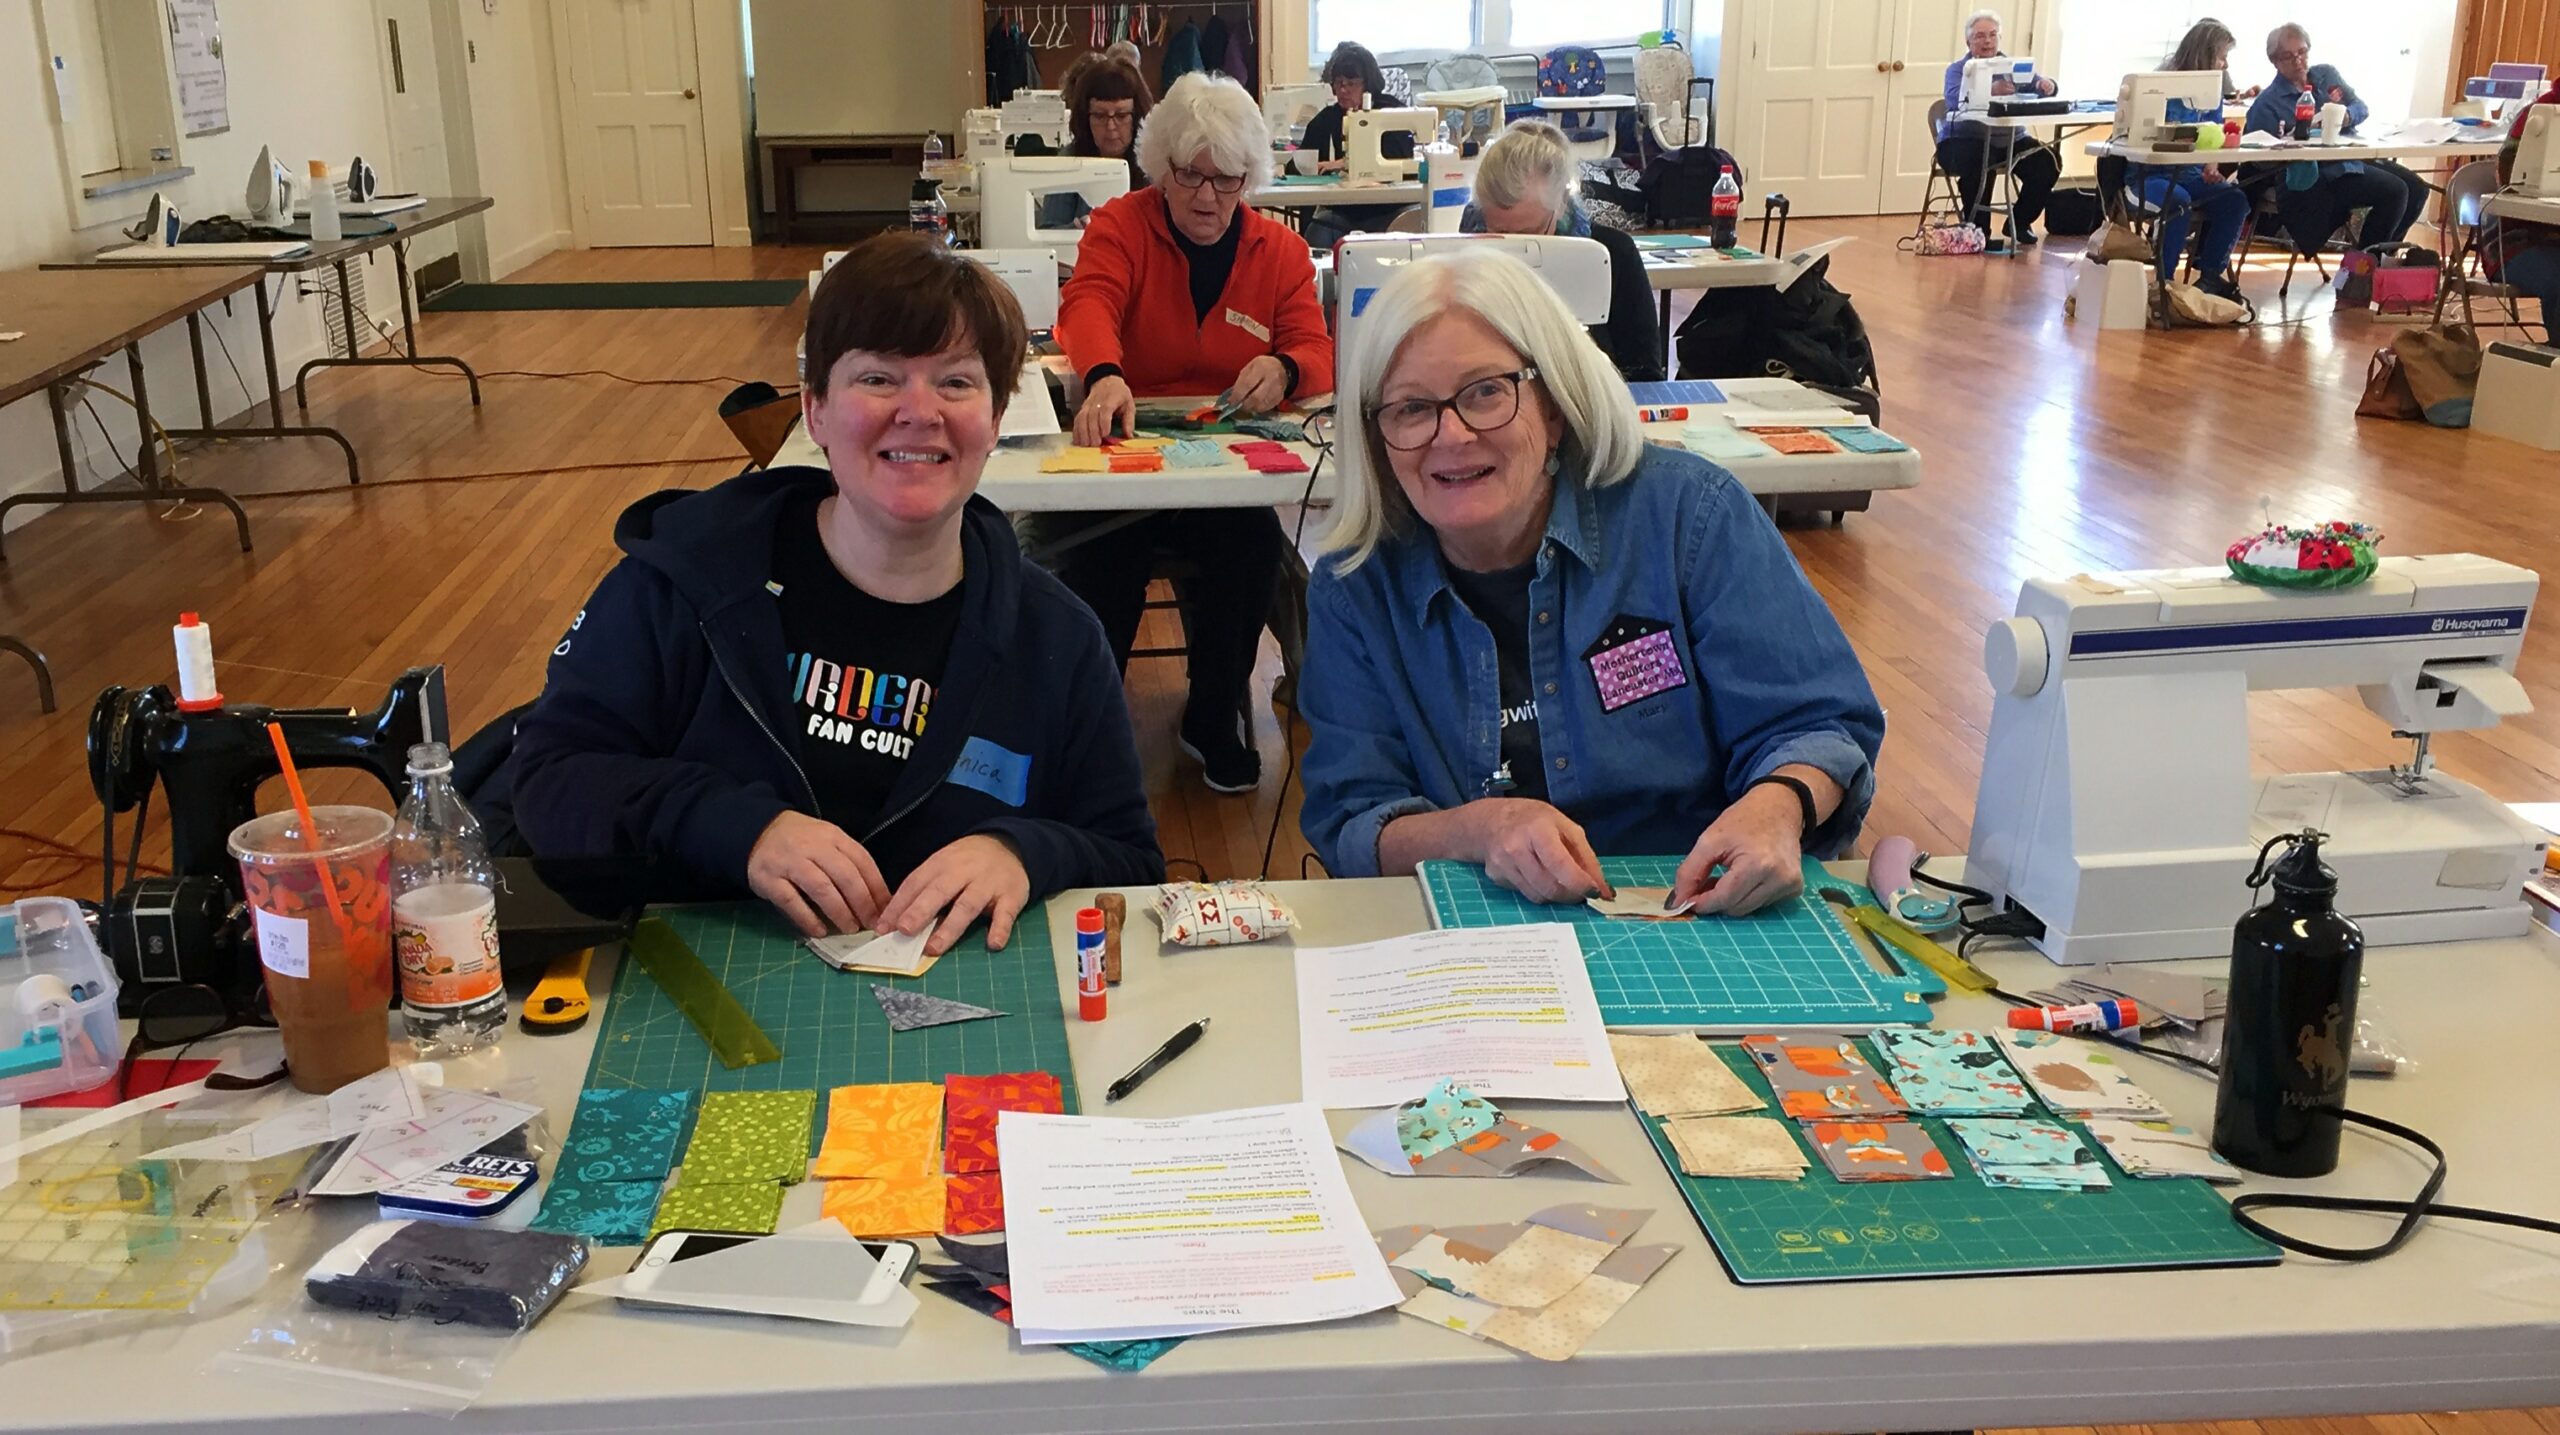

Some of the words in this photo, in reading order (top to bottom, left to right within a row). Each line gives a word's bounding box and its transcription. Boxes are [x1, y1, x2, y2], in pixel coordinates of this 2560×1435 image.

[2445, 617, 2509, 630] Husqvarna
[1600, 642, 1670, 673] Mothertown
[1616, 659, 1663, 682] Quilters
[1602, 674, 1661, 701] Lancaster
[807, 713, 854, 745] FAN
[860, 729, 915, 761] CULT
